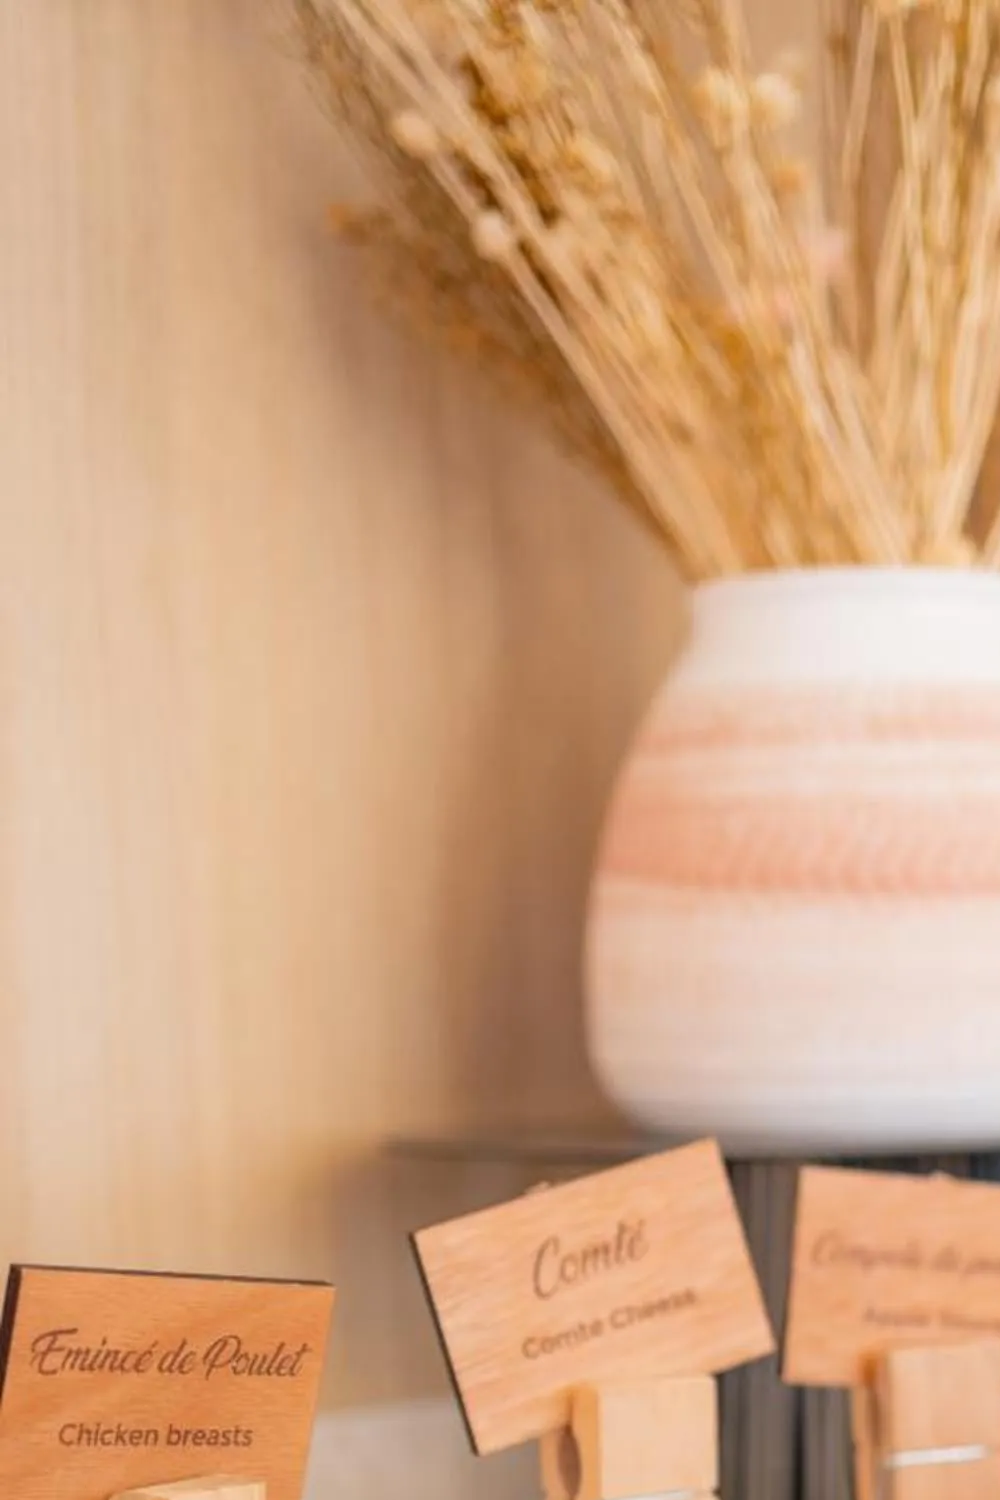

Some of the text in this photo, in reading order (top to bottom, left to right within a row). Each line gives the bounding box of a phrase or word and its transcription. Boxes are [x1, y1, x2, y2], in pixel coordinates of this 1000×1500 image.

[532, 1218, 650, 1300] Comté
[609, 1287, 698, 1329] Cheese
[30, 1327, 313, 1380] Emincé de Poulet
[58, 1422, 254, 1447] Chicken breasts
